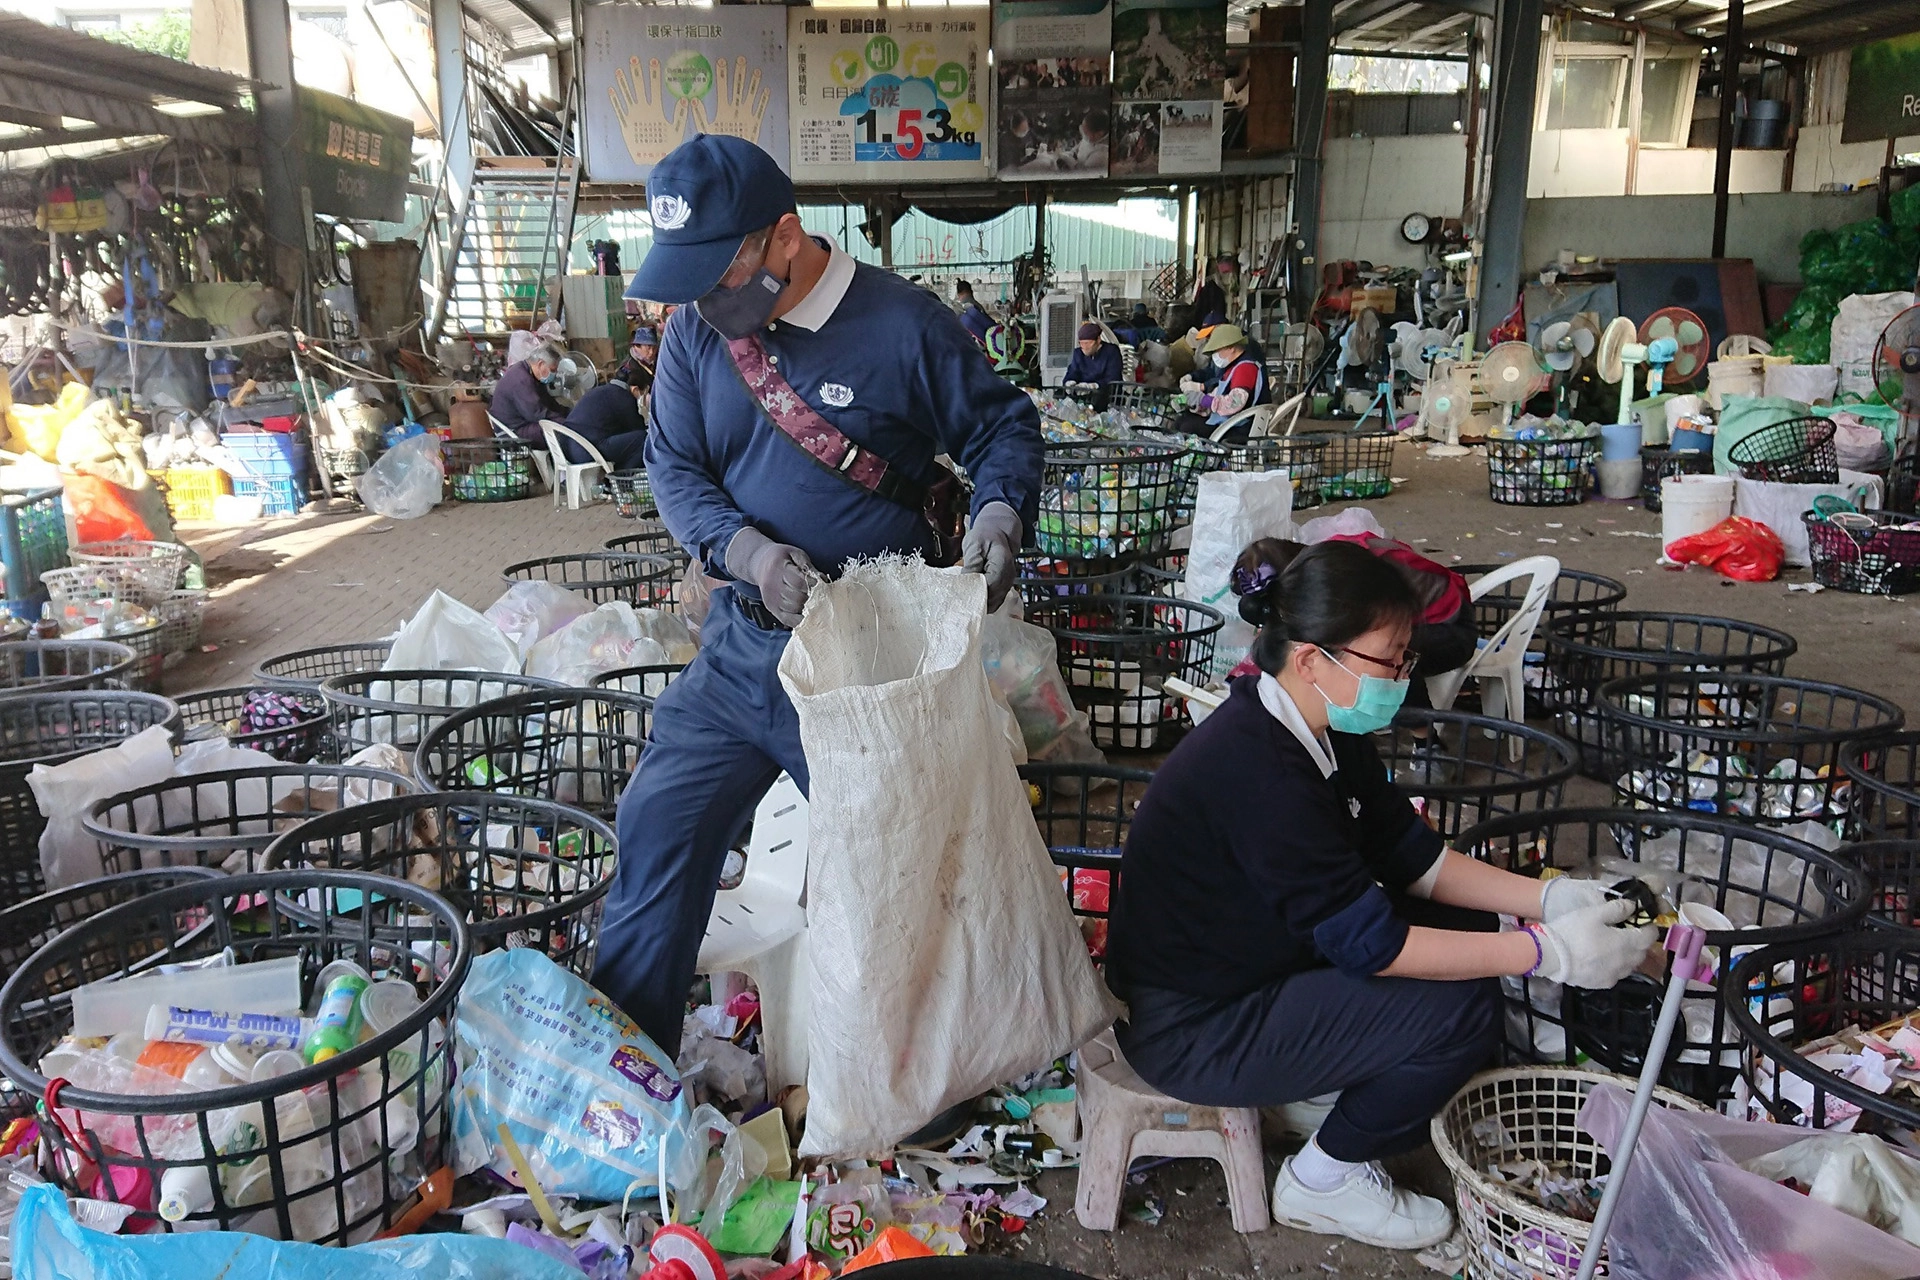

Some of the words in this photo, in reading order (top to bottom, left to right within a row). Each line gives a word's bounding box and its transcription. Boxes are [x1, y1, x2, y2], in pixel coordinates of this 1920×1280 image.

[647, 25, 722, 38] 環保十指口訣
